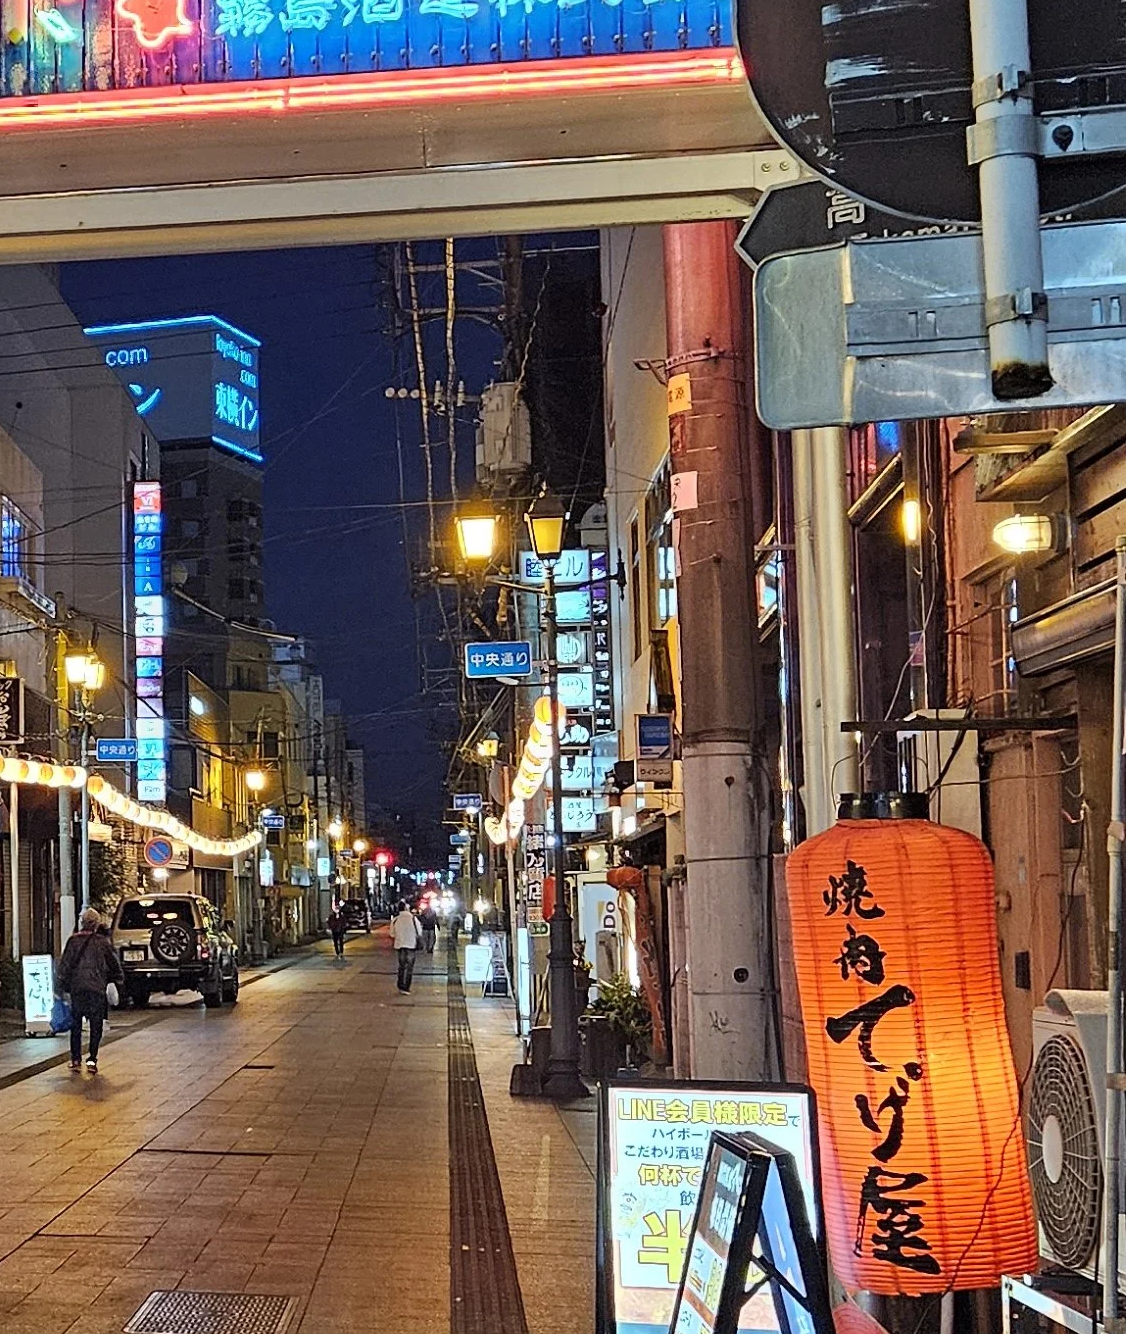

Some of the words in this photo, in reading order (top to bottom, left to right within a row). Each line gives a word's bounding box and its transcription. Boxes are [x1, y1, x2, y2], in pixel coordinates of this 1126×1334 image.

[215, 382, 259, 432] 東横イン
[470, 652, 528, 668] 中央通り
[99, 745, 135, 755] 中央通り
[617, 1098, 801, 1128] LINE会員様限定で
[625, 1144, 705, 1161] こだわり酒場
